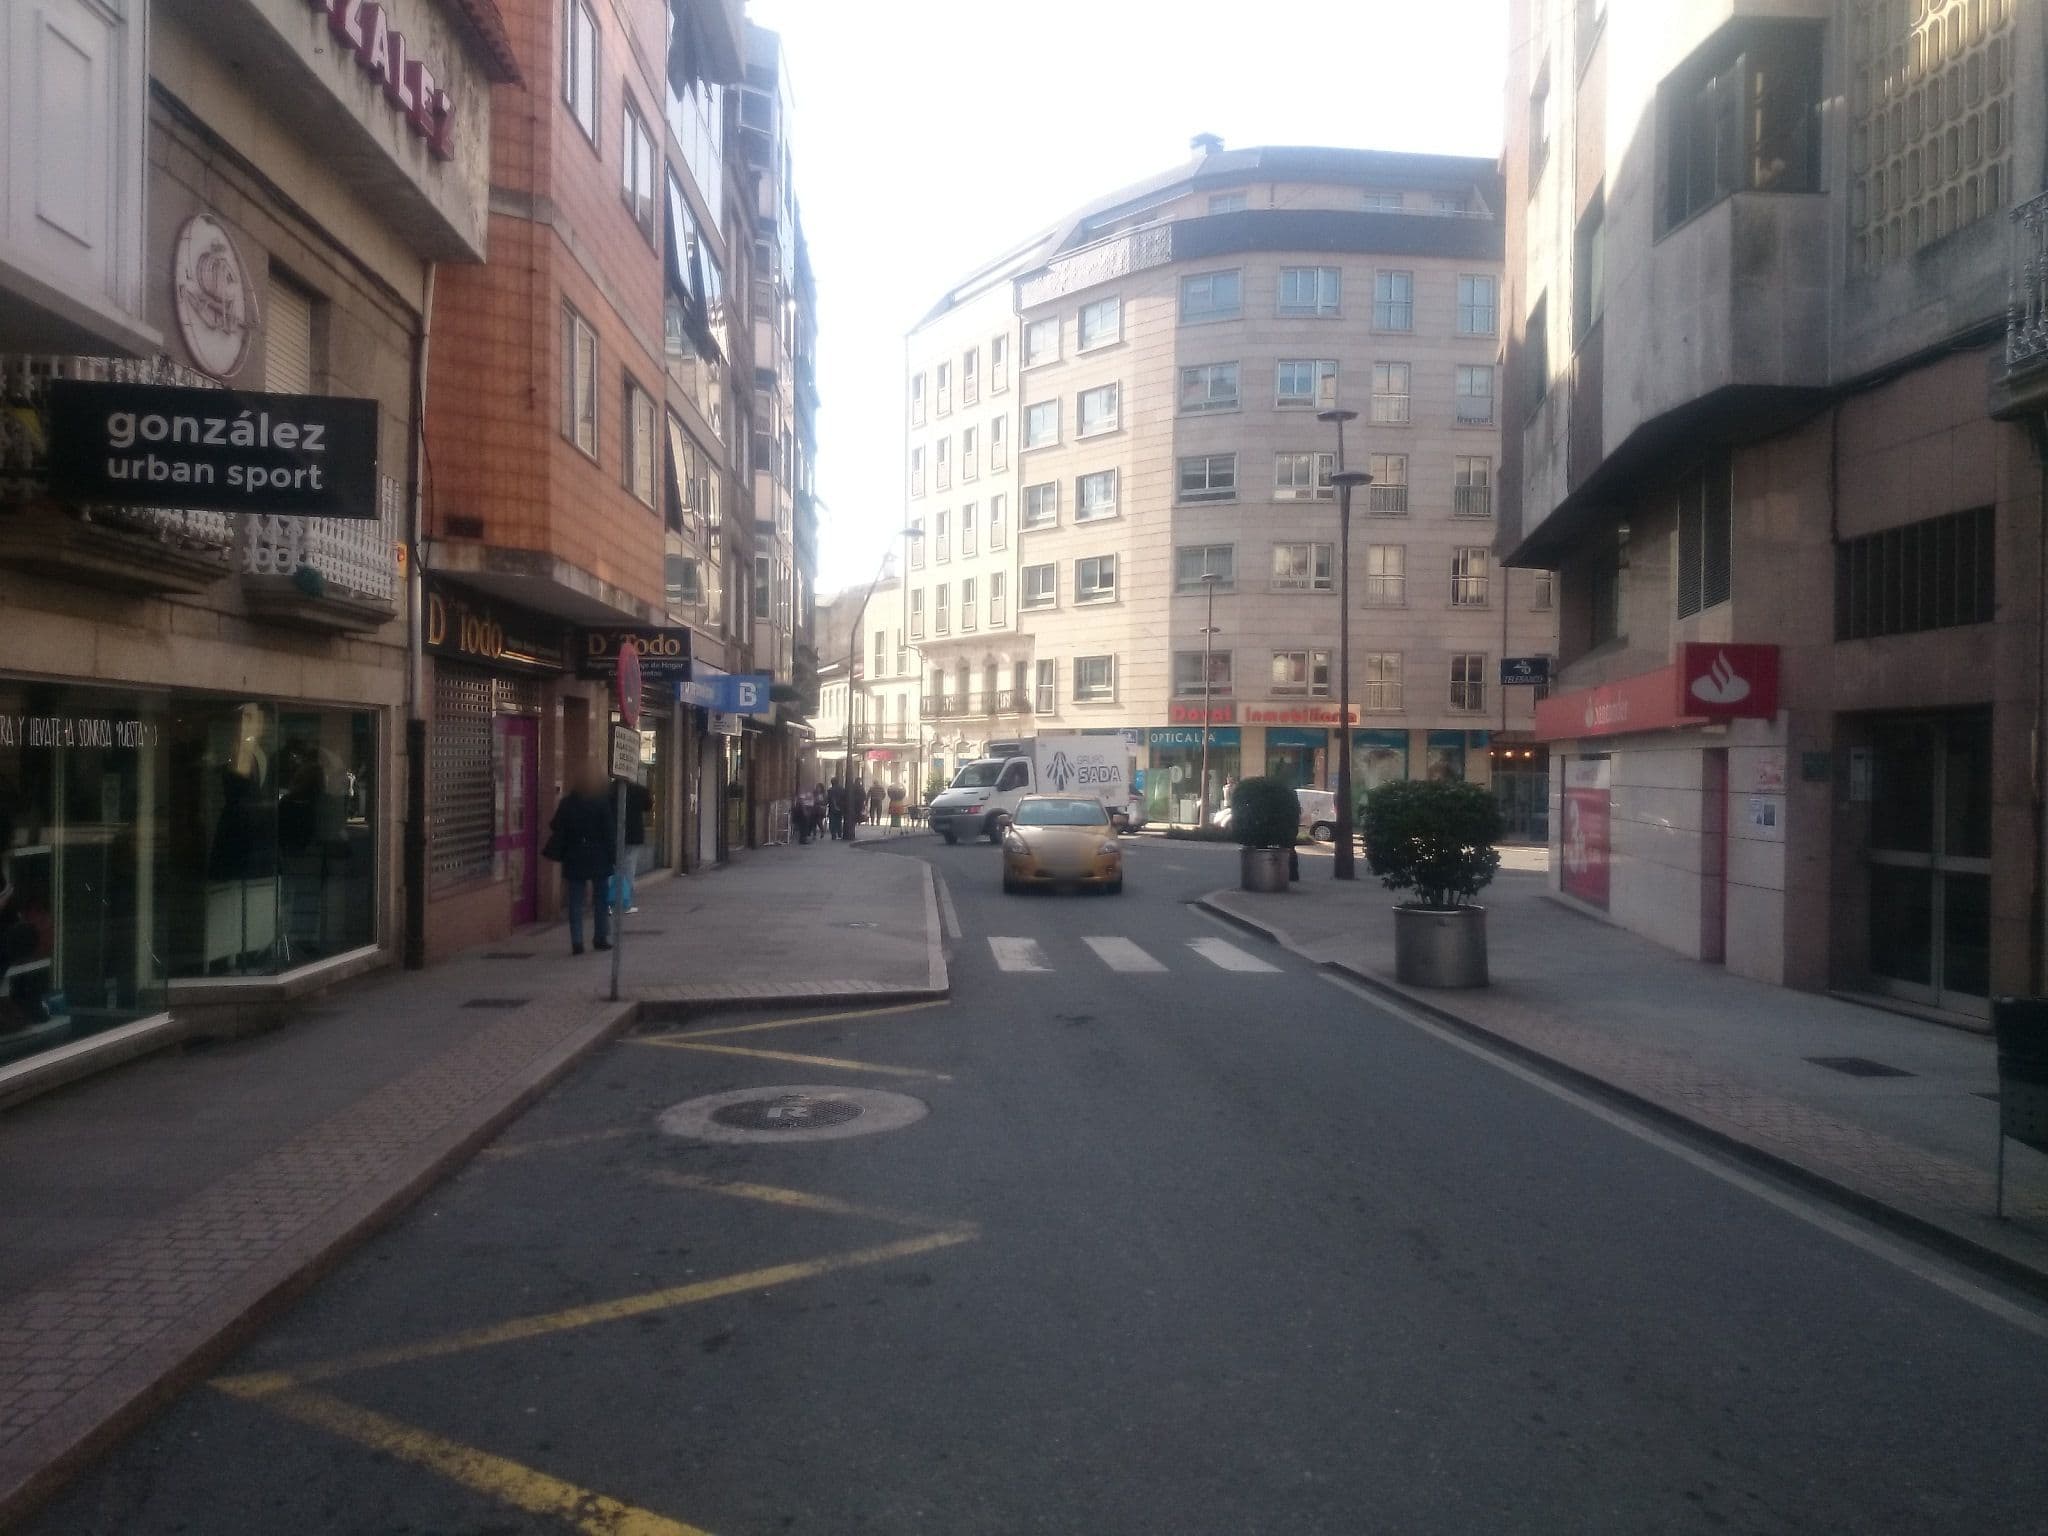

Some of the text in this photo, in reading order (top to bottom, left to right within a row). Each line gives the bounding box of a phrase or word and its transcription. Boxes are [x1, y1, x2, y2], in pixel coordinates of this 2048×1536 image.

[107, 409, 326, 451] gonzález
[107, 453, 323, 492] urban sport
[739, 682, 757, 706] B
[18, 715, 25, 746] Y
[1078, 765, 1121, 784] SADA
